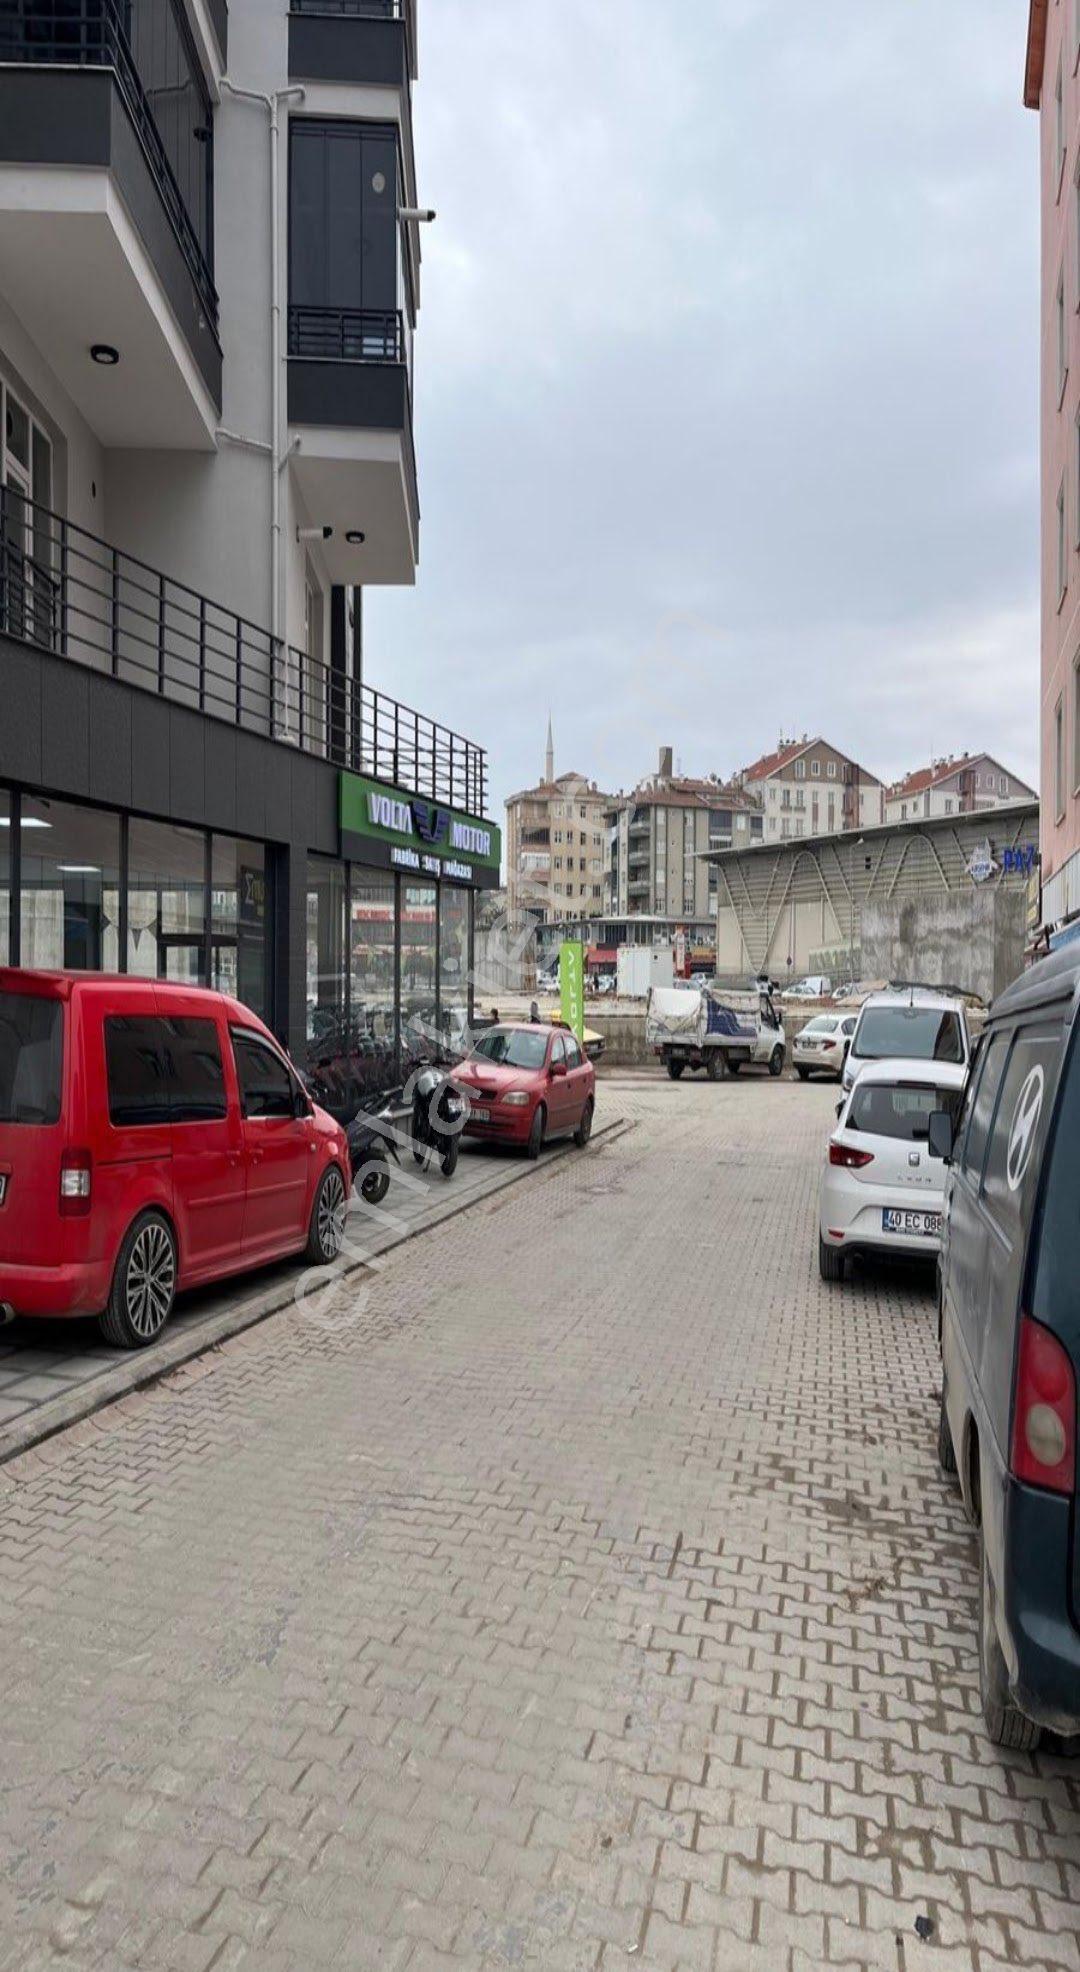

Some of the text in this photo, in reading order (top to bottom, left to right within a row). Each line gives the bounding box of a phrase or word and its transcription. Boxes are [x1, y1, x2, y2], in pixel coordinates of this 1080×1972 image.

[369, 792, 491, 857] VOLTA MOTOR
[889, 1211, 902, 1227] 40
[905, 1212, 920, 1229] EC
